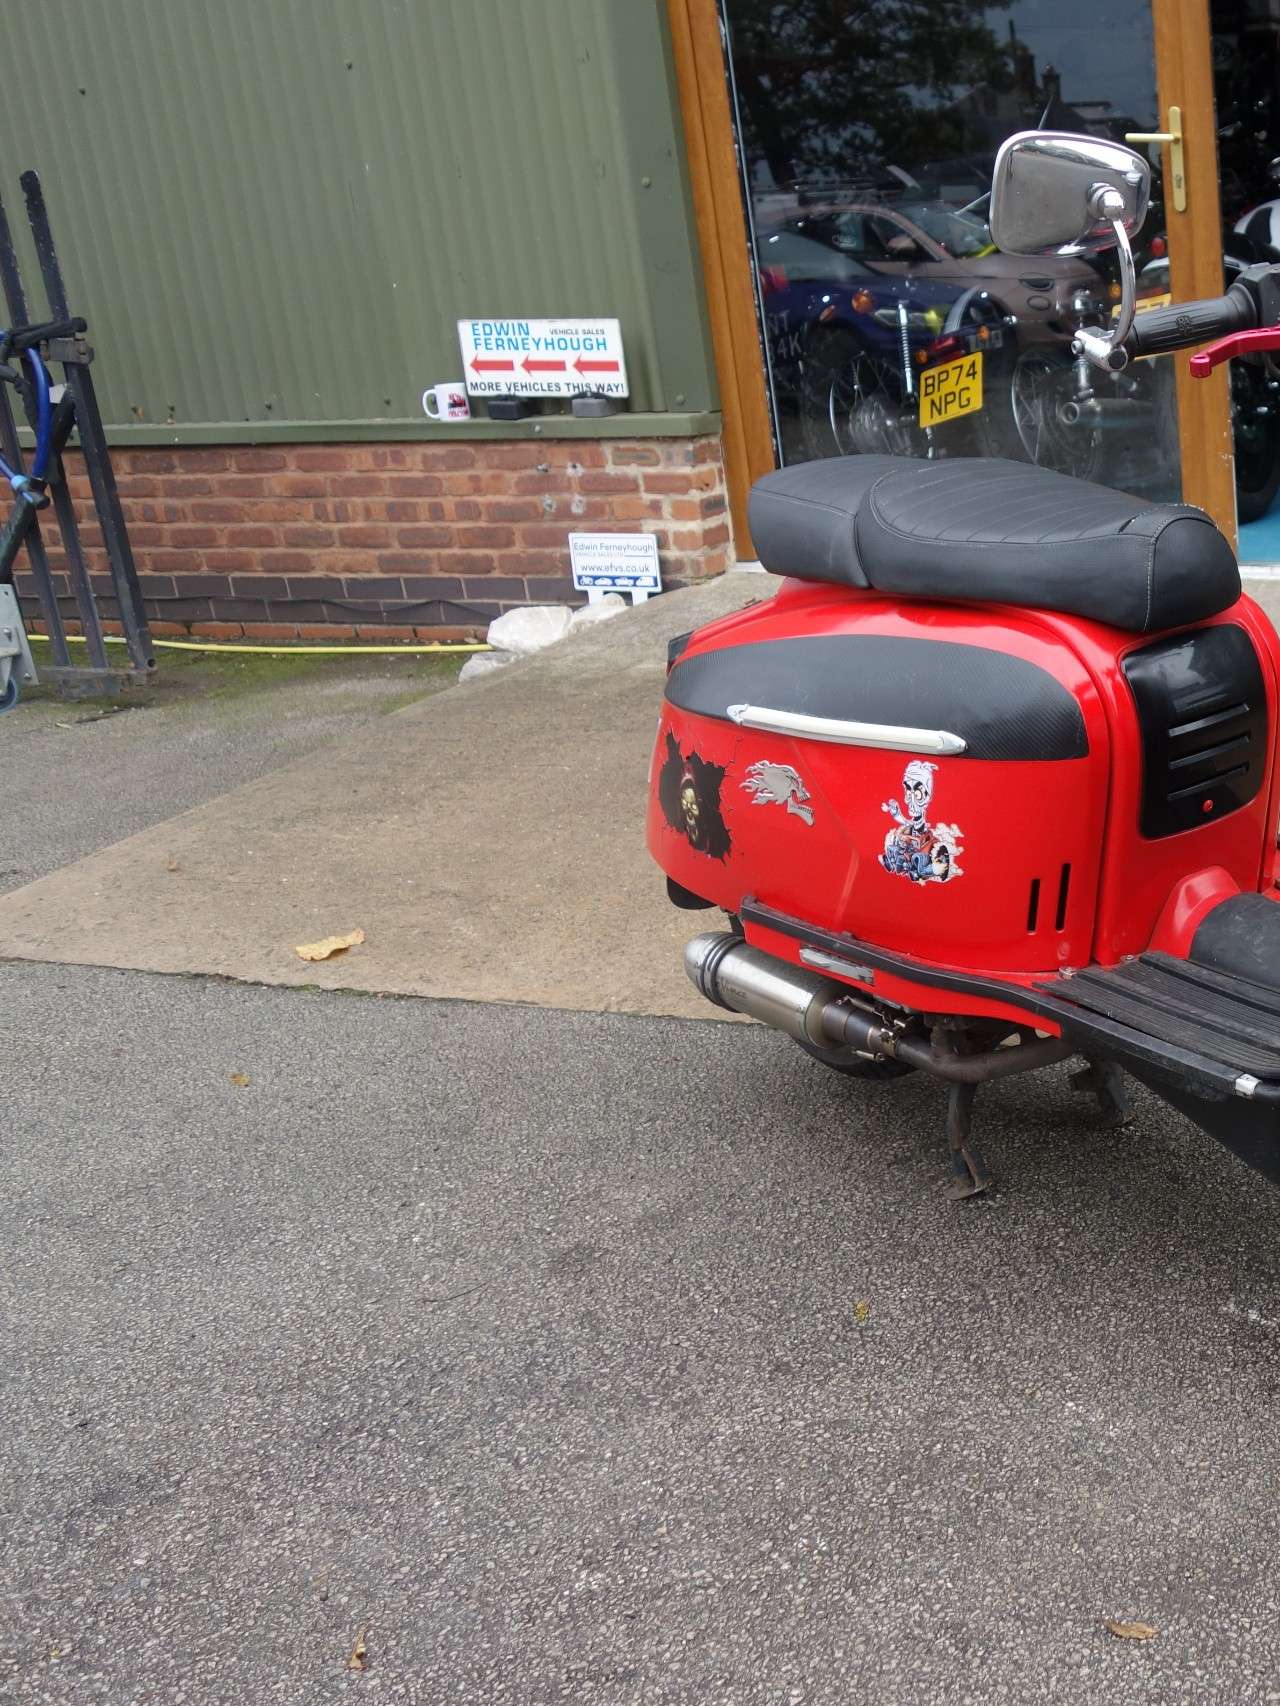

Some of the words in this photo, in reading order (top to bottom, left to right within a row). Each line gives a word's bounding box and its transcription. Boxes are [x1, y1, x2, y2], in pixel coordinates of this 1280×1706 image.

[471, 322, 530, 336] EDWIN
[473, 337, 608, 351] FERNEYHOUGH
[924, 360, 977, 397] BP74
[470, 382, 501, 392] MORE
[505, 382, 561, 392] VEHICLES
[565, 382, 591, 393] THIS
[595, 383, 624, 393] WAY!
[930, 386, 970, 419] NPG
[573, 542, 597, 551] Edwin
[600, 543, 653, 553] Ferneyhough
